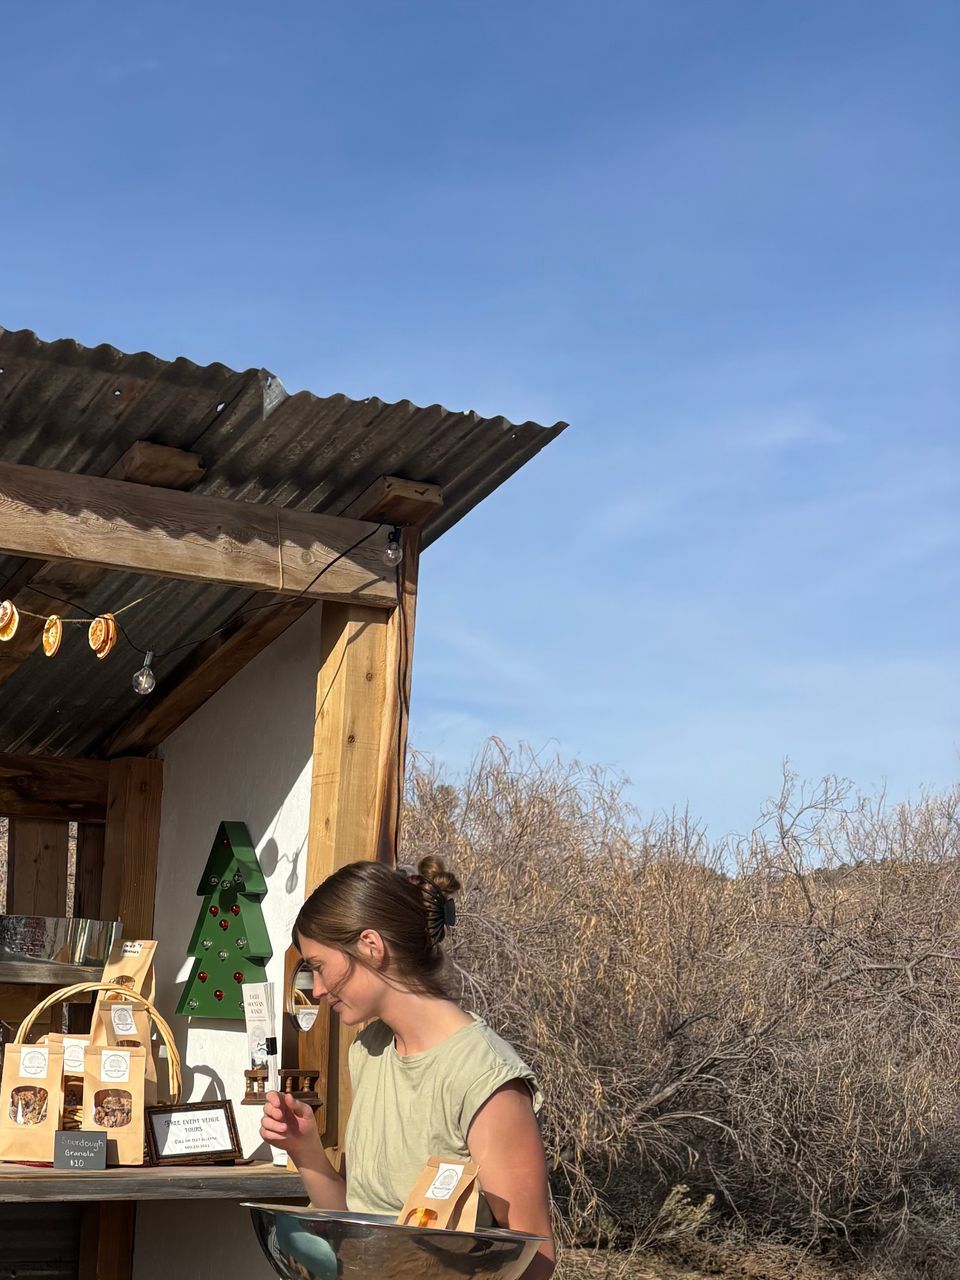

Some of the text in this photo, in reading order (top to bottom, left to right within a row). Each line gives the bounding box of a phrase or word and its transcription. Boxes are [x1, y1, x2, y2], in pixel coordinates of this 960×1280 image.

[61, 1136, 104, 1151] Sourdough
[65, 1150, 94, 1158] Granola
[70, 1160, 84, 1168] $10
